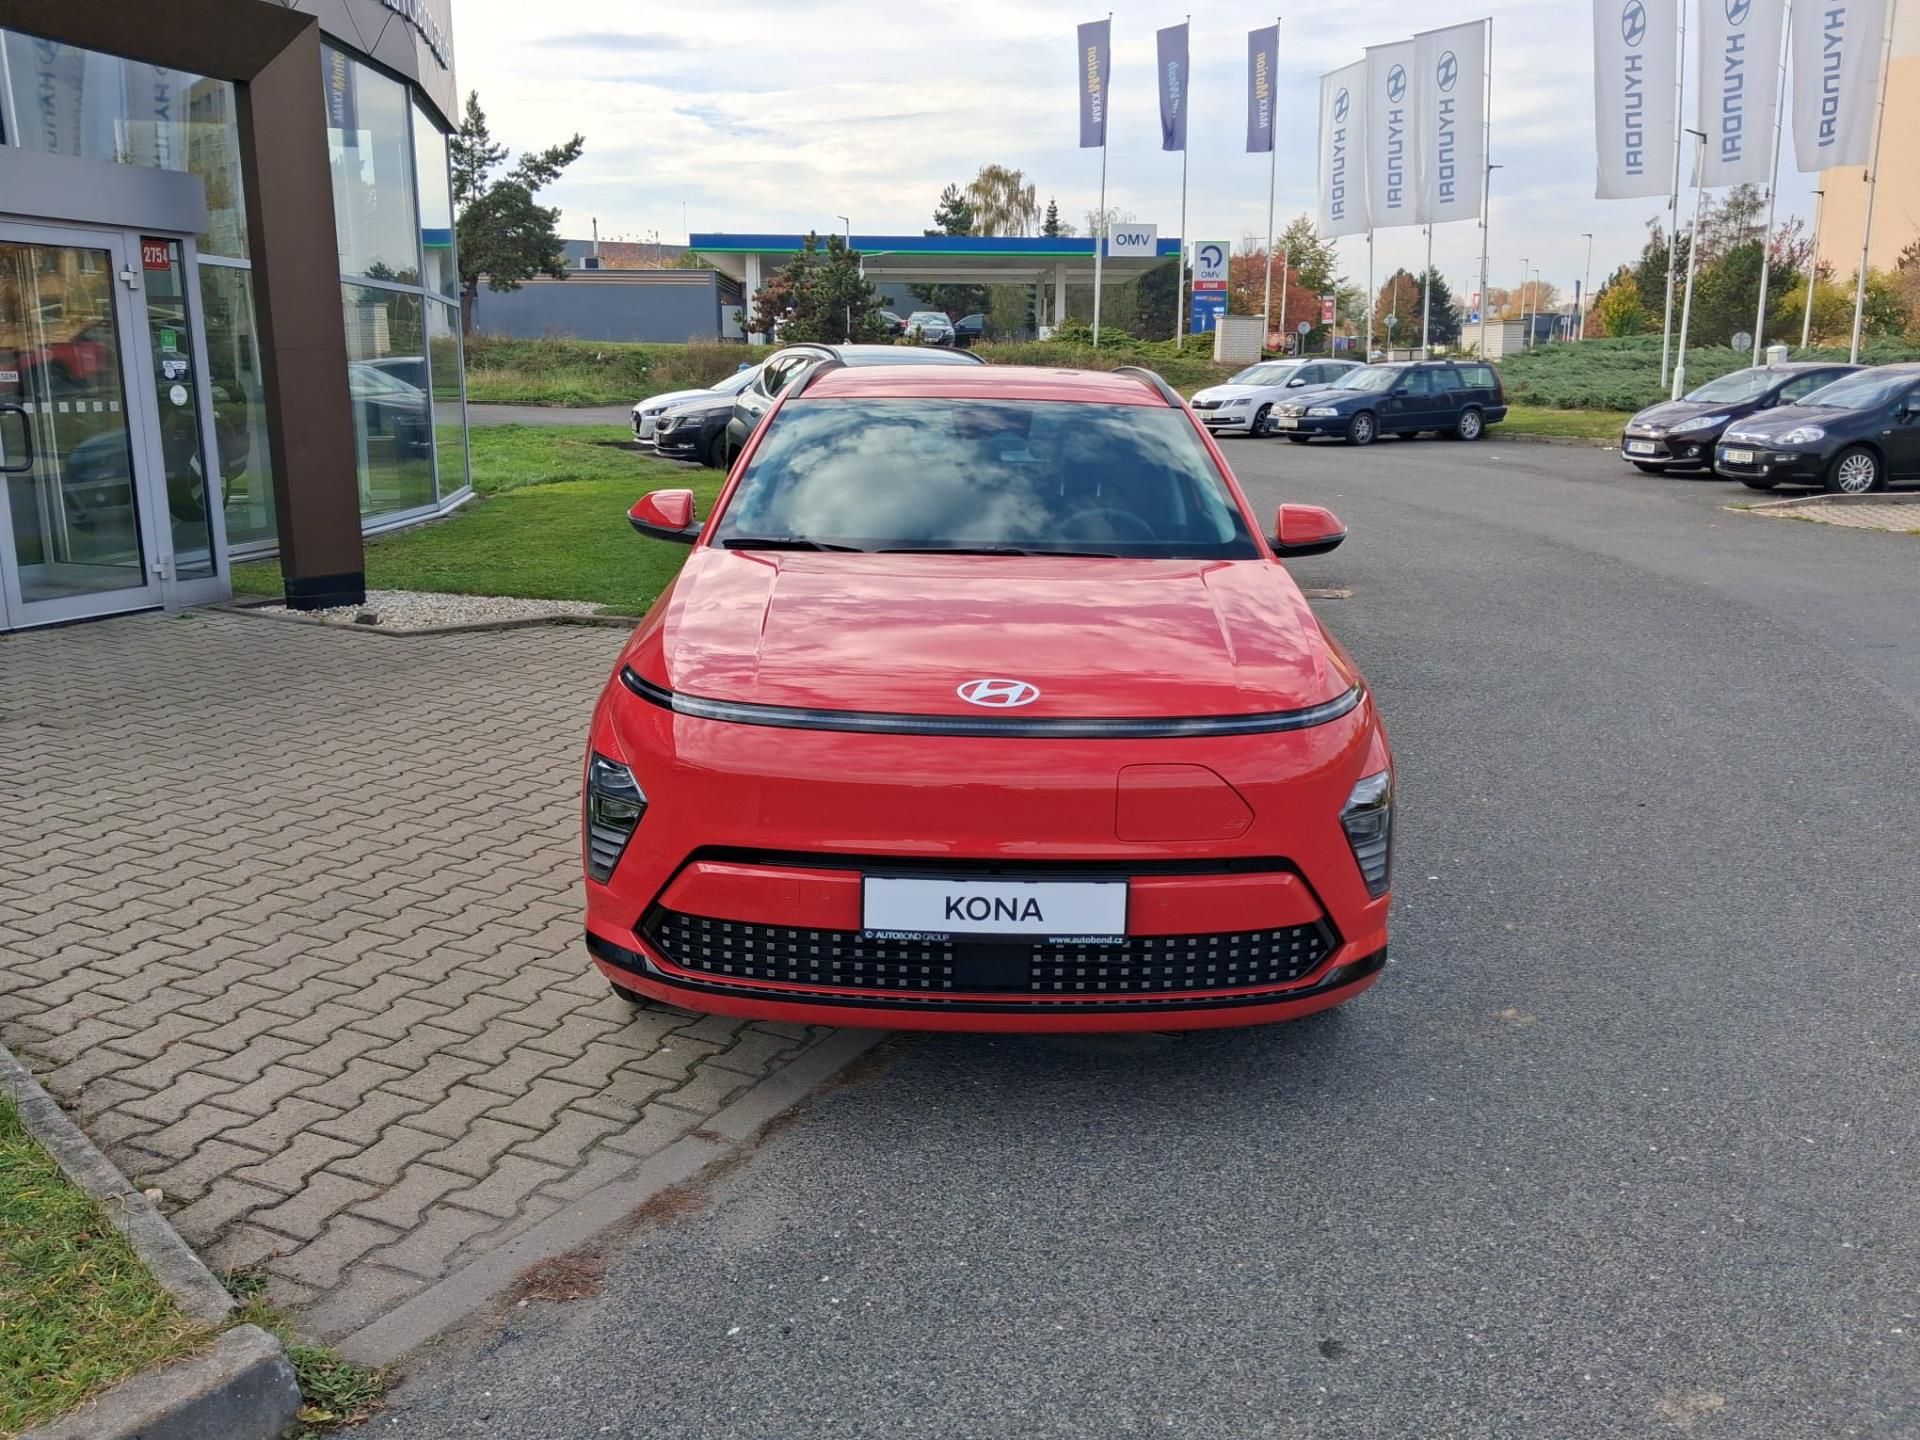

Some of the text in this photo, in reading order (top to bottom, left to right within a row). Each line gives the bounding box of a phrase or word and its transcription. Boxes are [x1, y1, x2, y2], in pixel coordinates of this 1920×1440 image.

[1116, 233, 1150, 246] OMV
[143, 246, 168, 263] 2754
[1200, 271, 1221, 279] OMV
[945, 895, 1044, 922] KONA
[876, 931, 950, 941] AUTOBOND GROUP
[1048, 935, 1123, 944] www.autobond.cz
